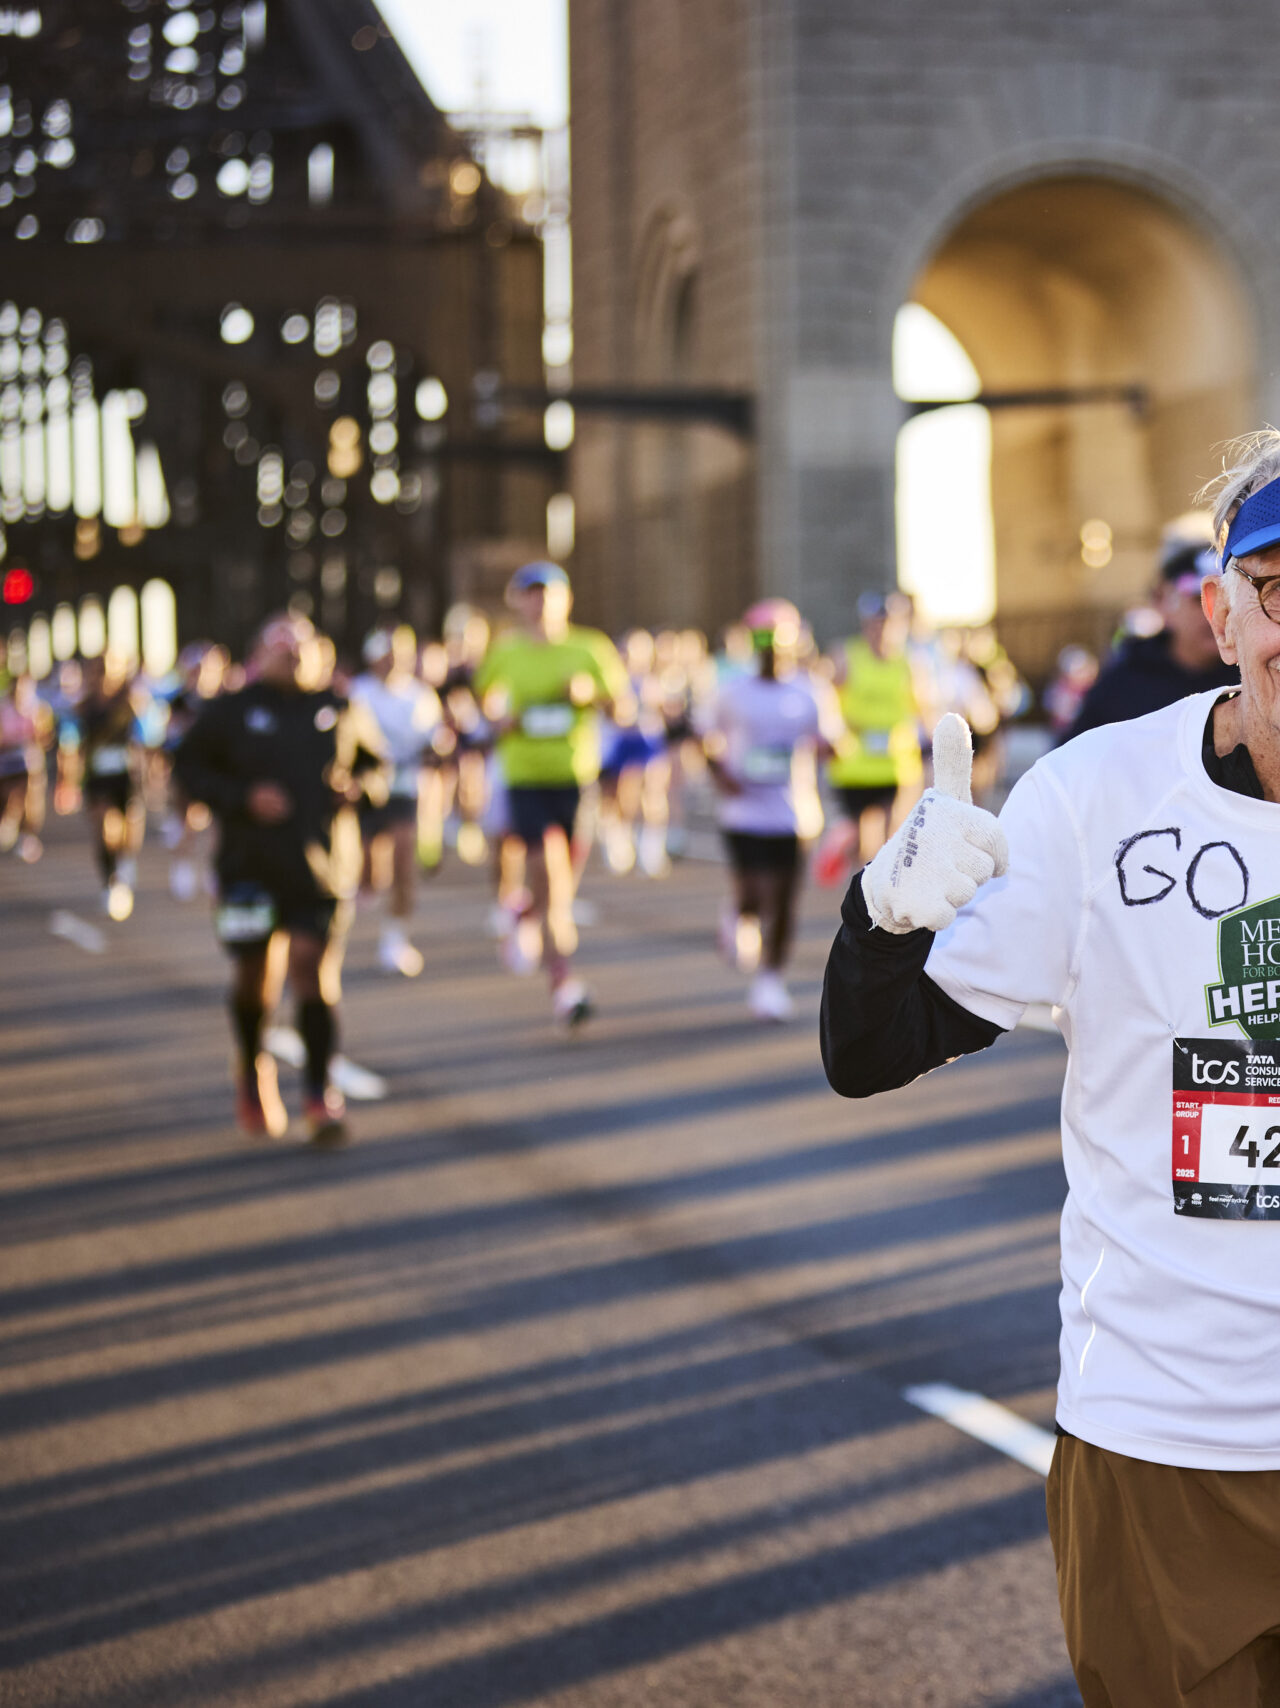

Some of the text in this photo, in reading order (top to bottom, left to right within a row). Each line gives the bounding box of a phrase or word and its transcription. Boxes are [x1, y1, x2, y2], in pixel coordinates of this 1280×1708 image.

[1114, 827, 1249, 919] GO
[1243, 966, 1265, 978] FOR
[1246, 1055, 1275, 1065] TATA
[1192, 1053, 1239, 1085] tcs
[1176, 1101, 1199, 1109] START
[1268, 1097, 1280, 1105] RED
[1175, 1110, 1199, 1118] GROUP
[1181, 1134, 1190, 1155] 1
[1175, 1168, 1195, 1178] 2025
[1256, 1192, 1280, 1208] tcs
